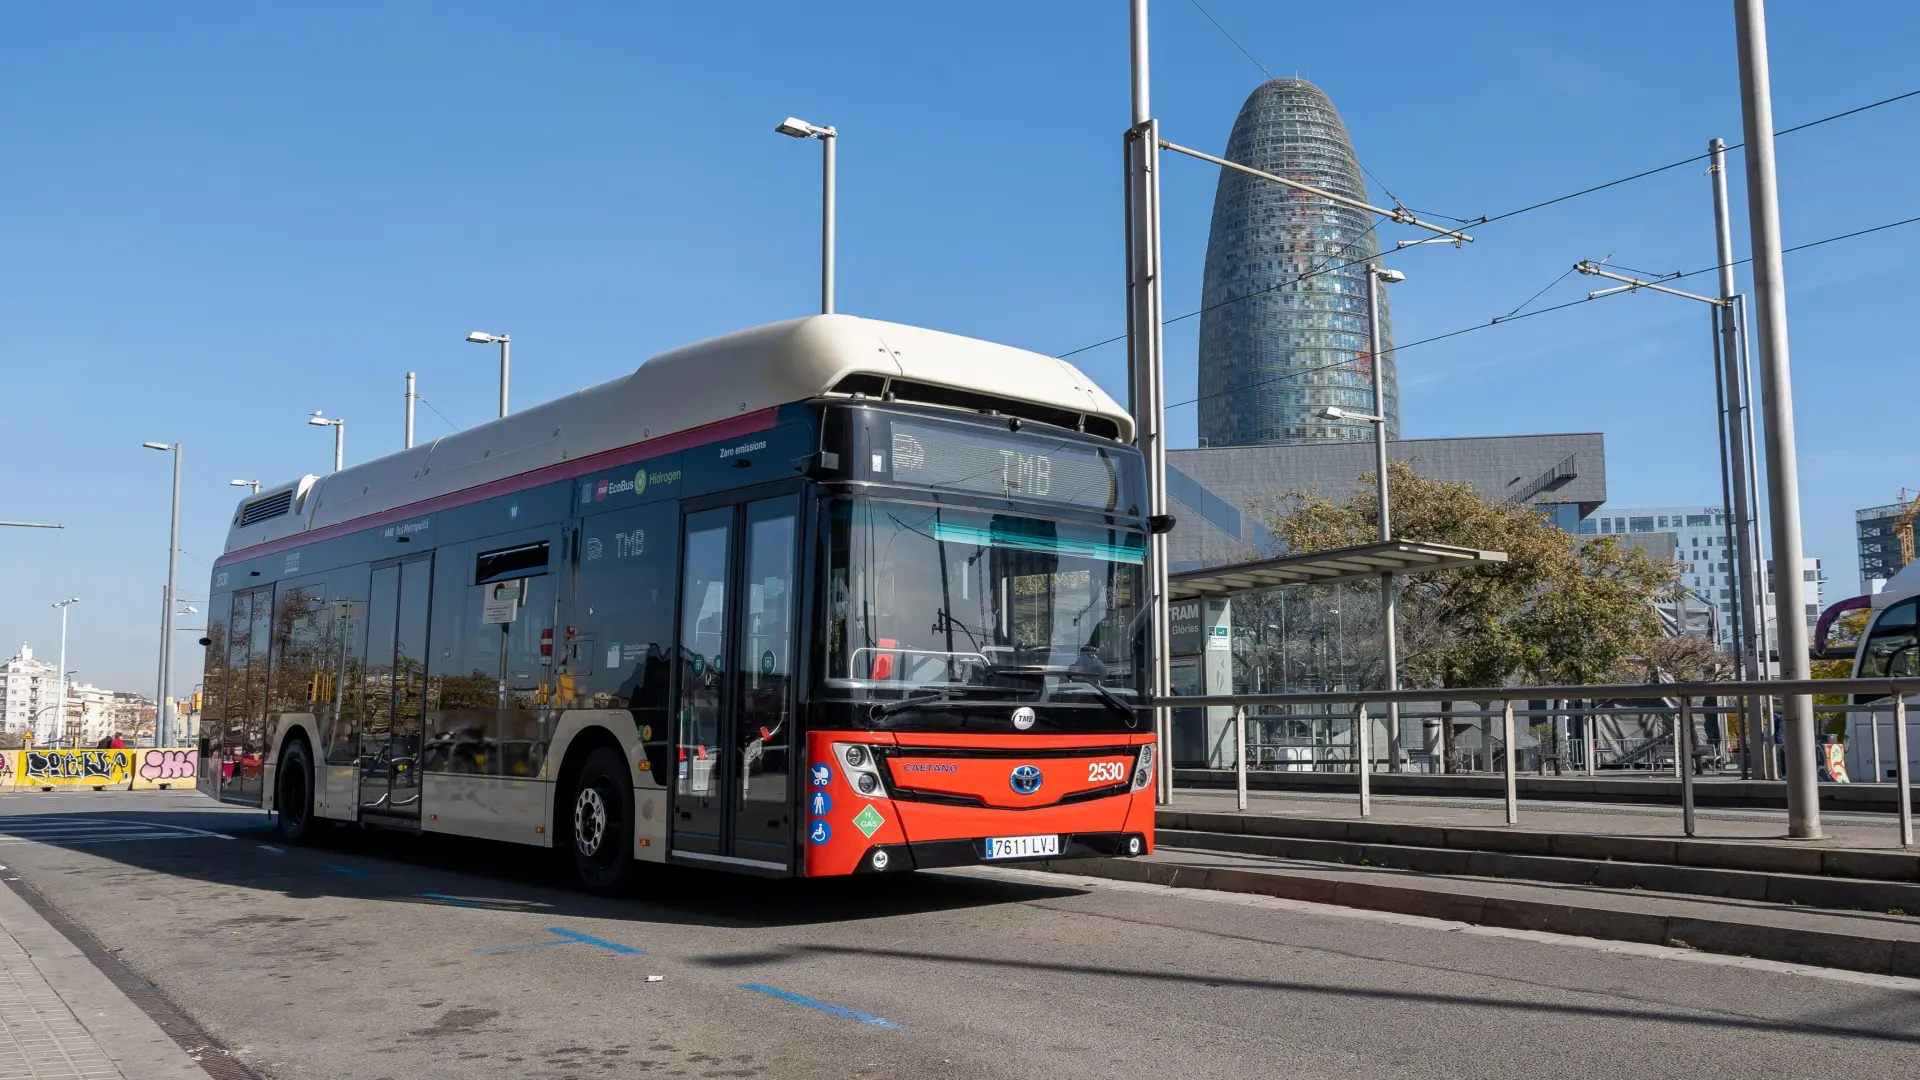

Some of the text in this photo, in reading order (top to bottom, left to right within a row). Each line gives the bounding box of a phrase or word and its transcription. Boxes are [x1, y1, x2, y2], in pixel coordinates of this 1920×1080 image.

[720, 440, 767, 459] Zero emissions
[999, 449, 1051, 496] TMB
[608, 470, 681, 495] EcoBus Hidrogen
[615, 529, 644, 559] TMB
[1172, 624, 1199, 635] Glòries
[1018, 715, 1034, 723] TMB
[904, 763, 958, 773] CAETANO
[1088, 761, 1124, 782] 2530
[860, 820, 878, 828] GAS
[995, 837, 1056, 856] 7611 LVJ
